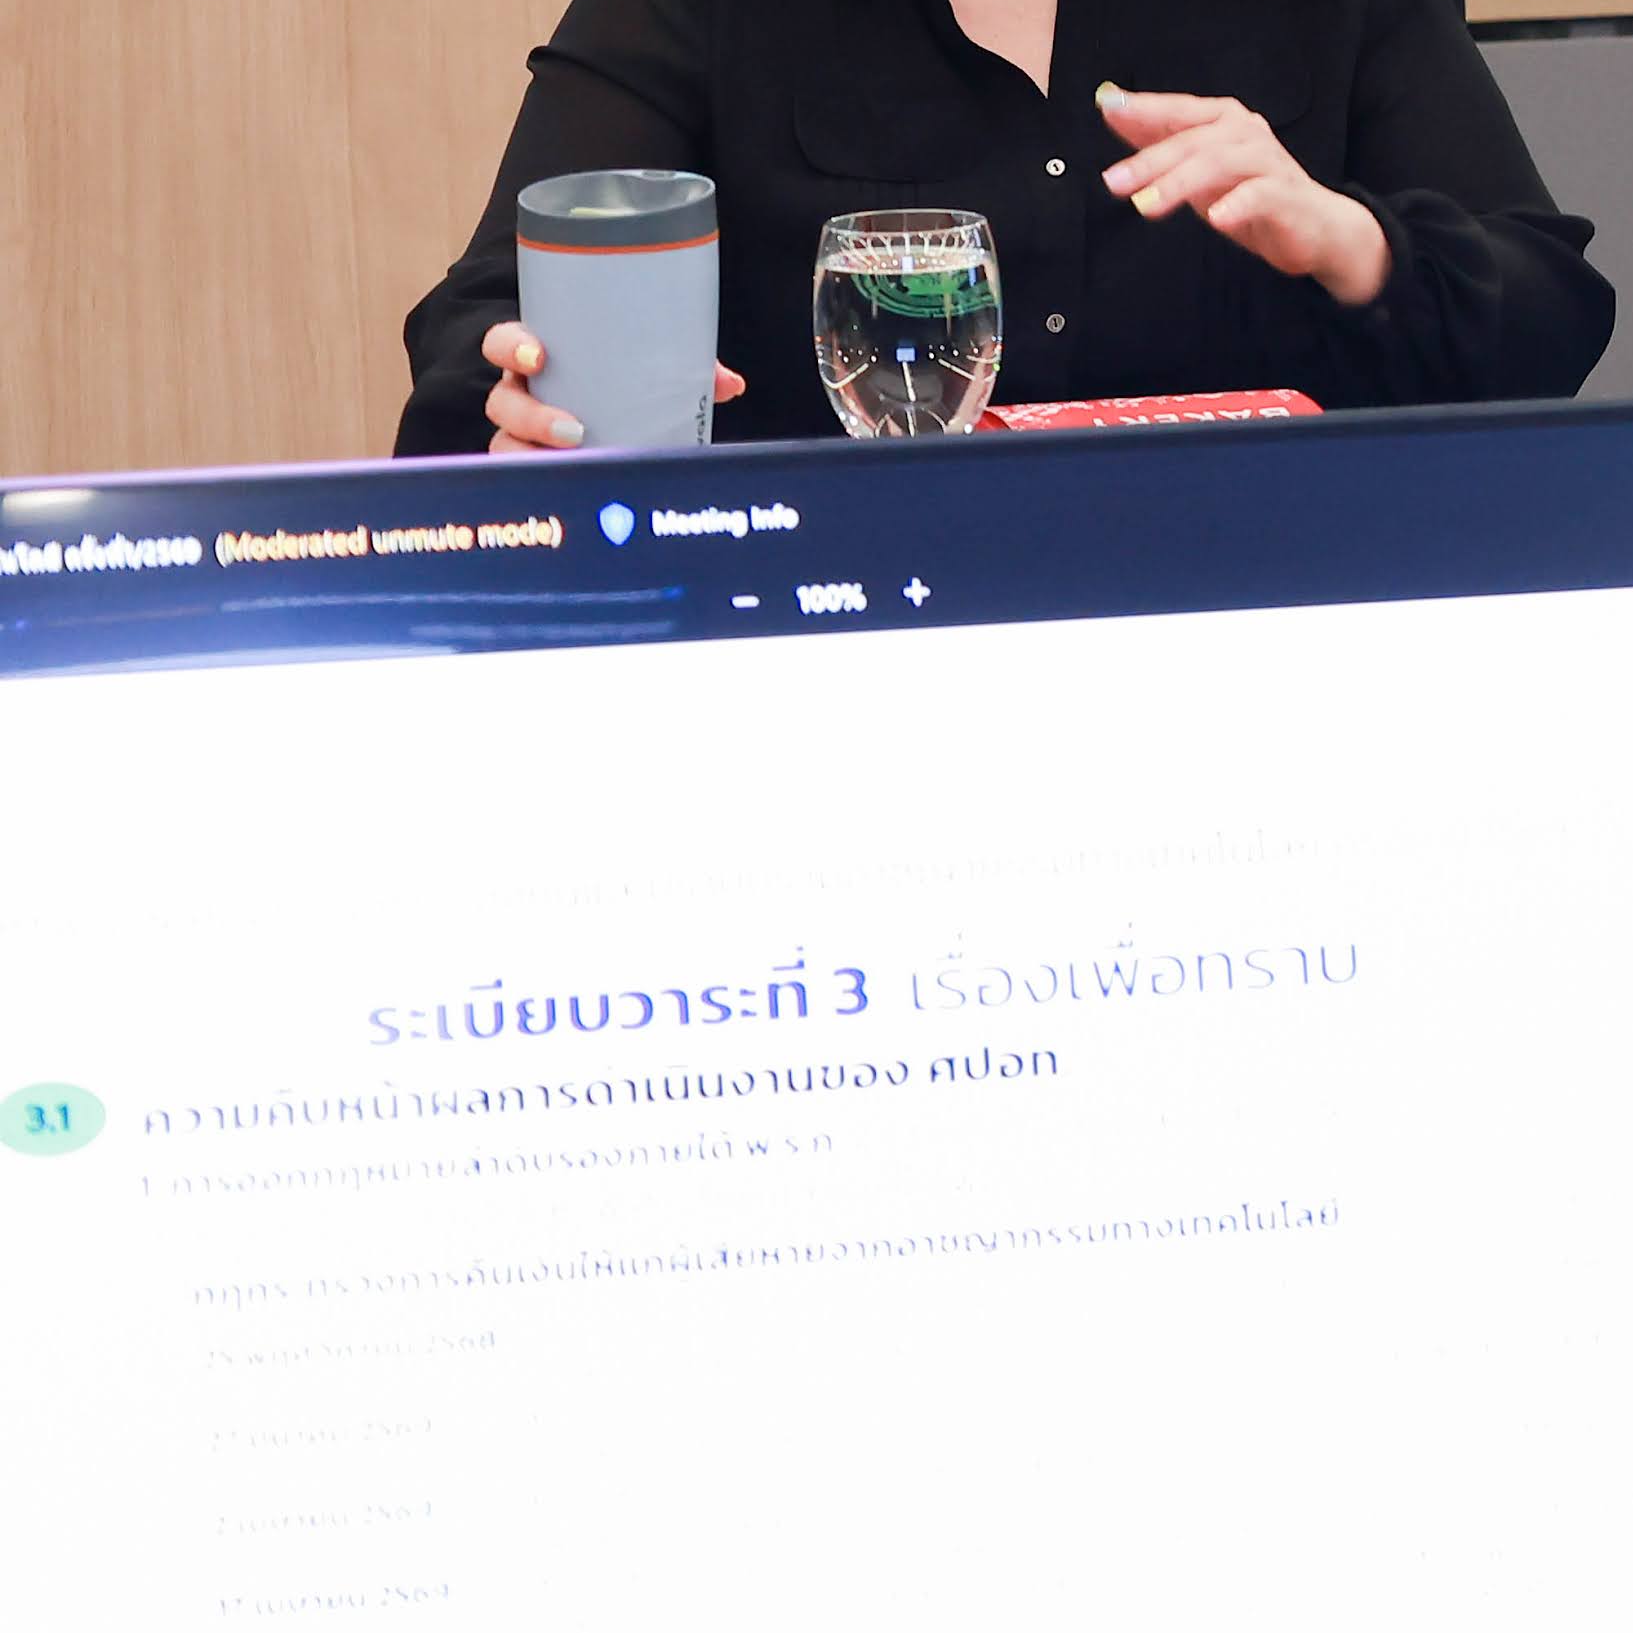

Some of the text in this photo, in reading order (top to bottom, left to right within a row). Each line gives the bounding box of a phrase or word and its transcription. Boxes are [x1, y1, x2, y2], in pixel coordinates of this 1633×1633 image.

[652, 502, 799, 538] Meeting Info
[215, 528, 369, 567] (Moderated
[371, 523, 475, 555] unmute
[477, 516, 562, 549] mode)
[796, 582, 867, 614] 100%
[368, 922, 1358, 1046] ระเบียบวาระที่ 3 เรื่องเพื่อทราบ
[27, 1103, 70, 1135] 3.1
